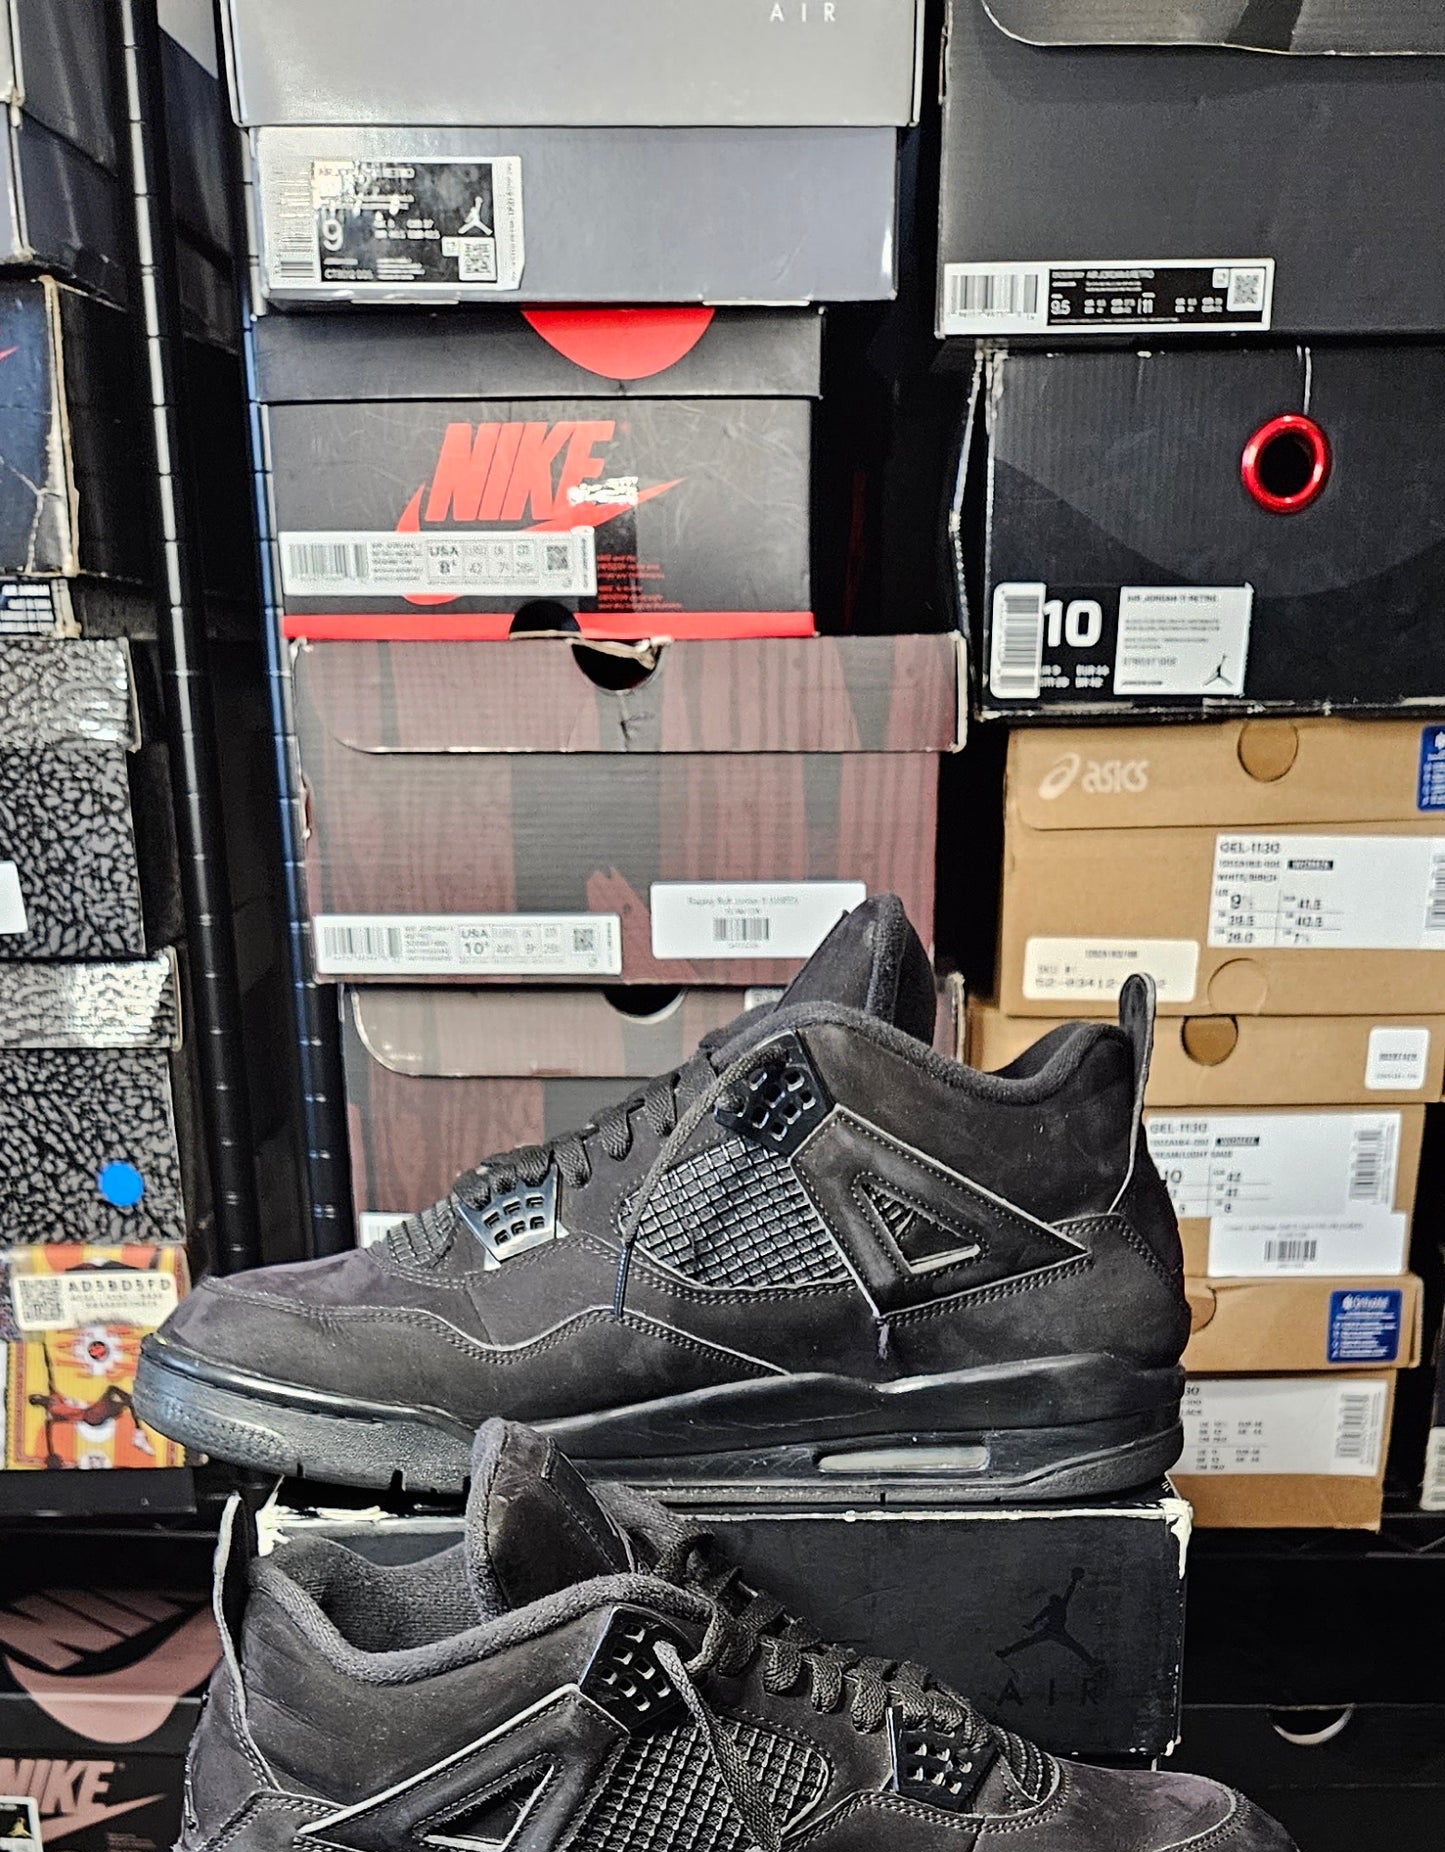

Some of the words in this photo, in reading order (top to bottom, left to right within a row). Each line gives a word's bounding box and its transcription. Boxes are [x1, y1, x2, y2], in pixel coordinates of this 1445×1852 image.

[769, 3, 836, 22] AIR
[424, 420, 616, 522] NIKE
[1043, 599, 1102, 647] 10
[1081, 759, 1150, 793] asics
[996, 1678, 1099, 1707] AIR
